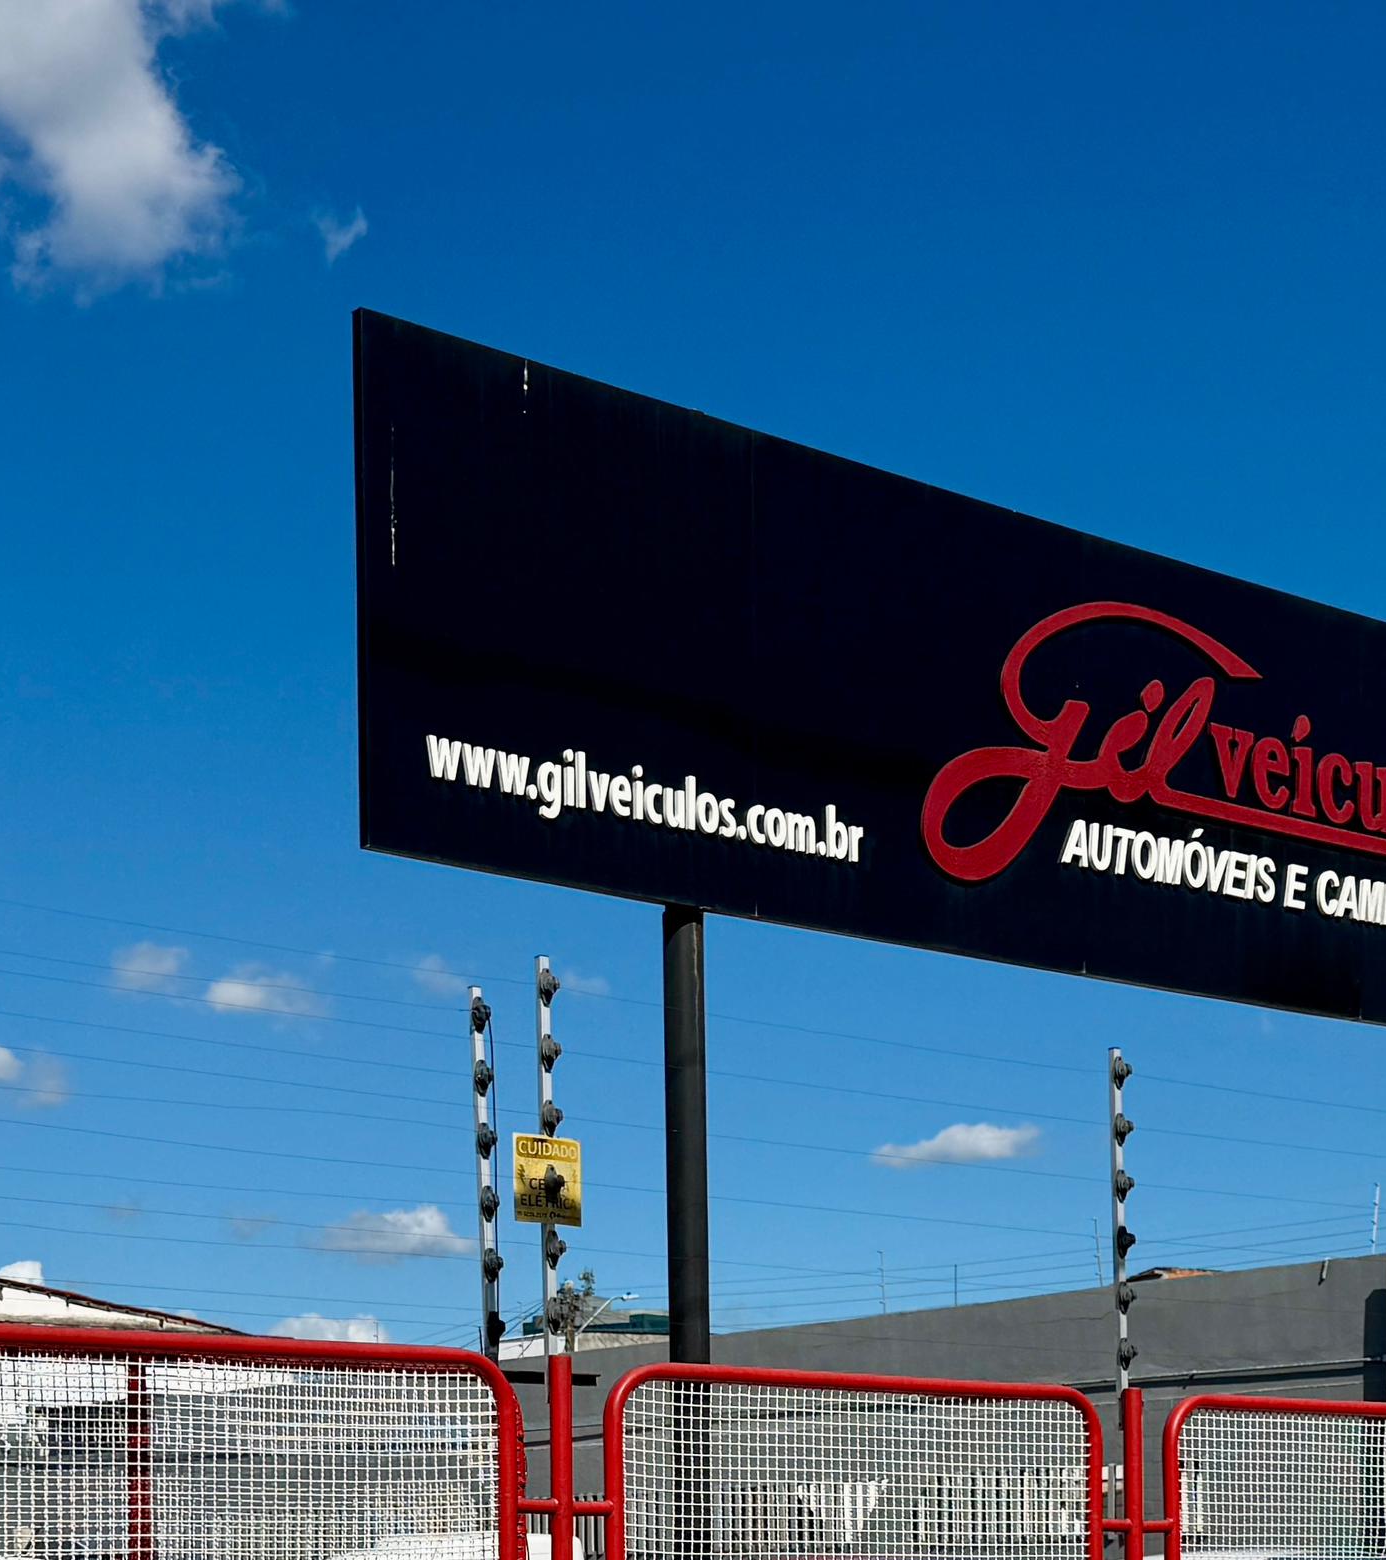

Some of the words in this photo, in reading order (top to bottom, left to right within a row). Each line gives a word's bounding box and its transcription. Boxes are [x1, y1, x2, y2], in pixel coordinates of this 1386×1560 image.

[425, 733, 865, 864] www.gilveiculos.com.br
[1059, 818, 1277, 902] AUTOMÓVEIS
[1282, 863, 1309, 910] E
[518, 1139, 578, 1160] CUIDADO
